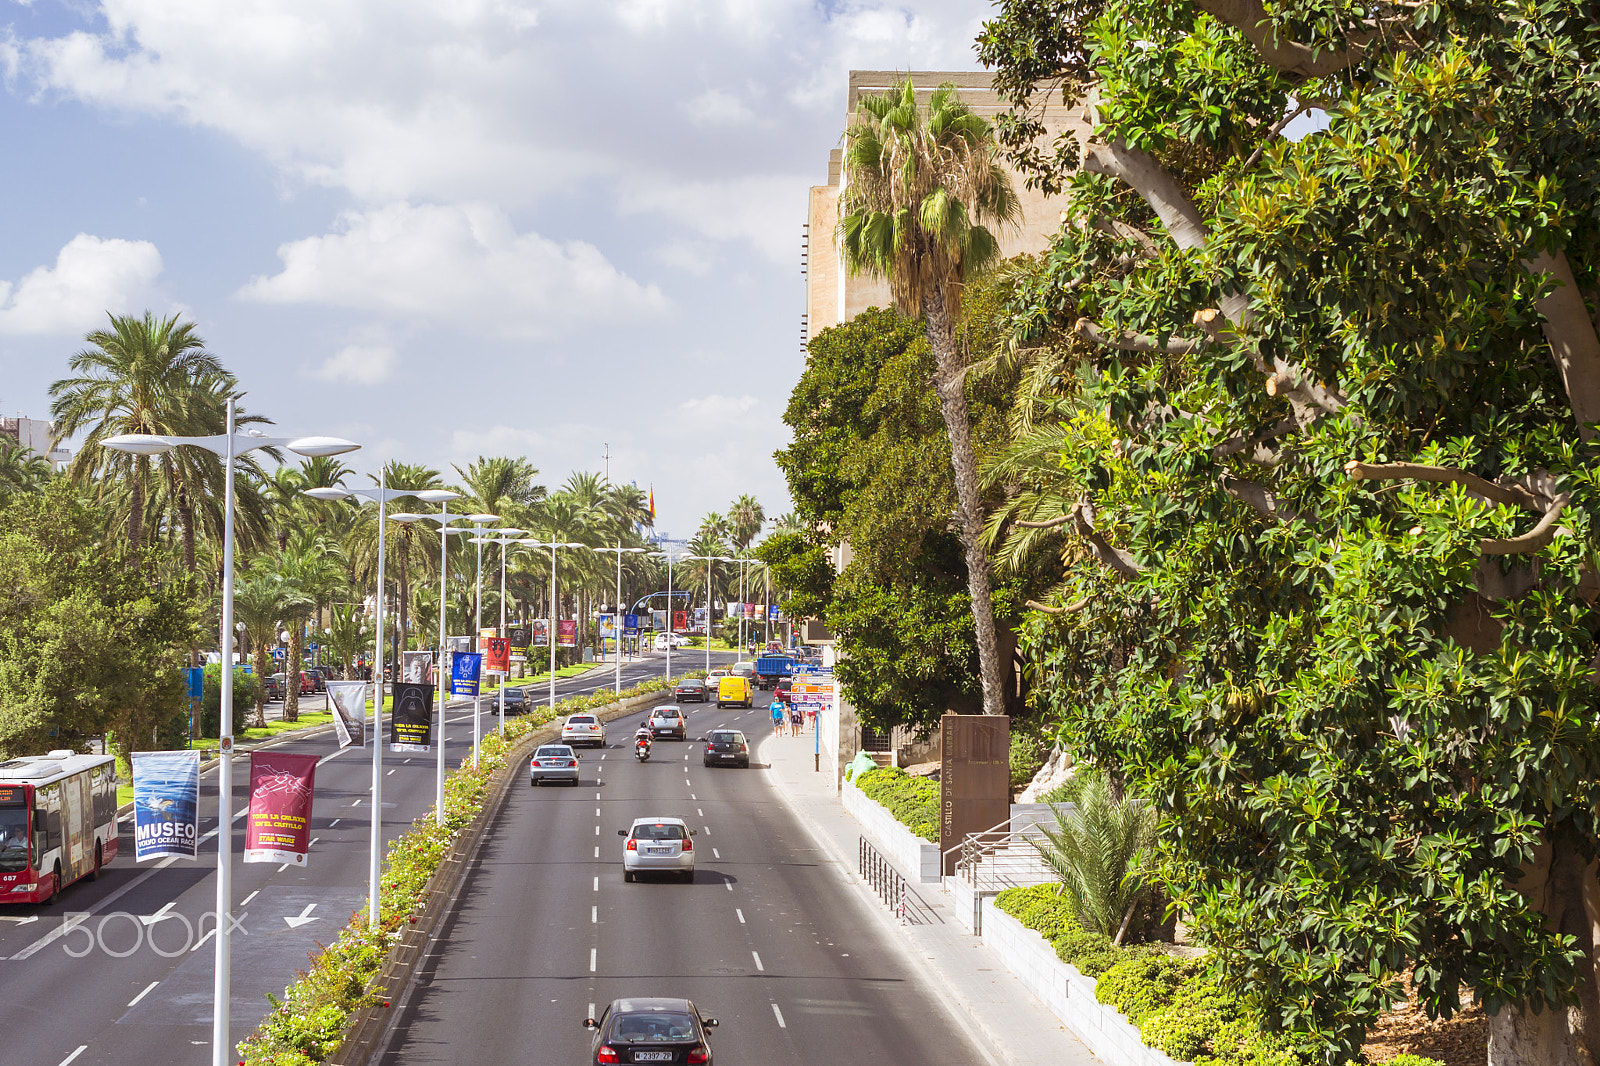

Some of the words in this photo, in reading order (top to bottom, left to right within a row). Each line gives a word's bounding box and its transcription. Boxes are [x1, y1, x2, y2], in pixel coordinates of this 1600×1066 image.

[945, 758, 953, 784] SANTA
[945, 786, 953, 797] DE
[280, 814, 306, 824] GALAXIA
[944, 801, 953, 837] CASTILLO
[138, 822, 194, 840] MUSEO
[273, 822, 302, 830] CASTILLO
[138, 838, 156, 847] VOLVO
